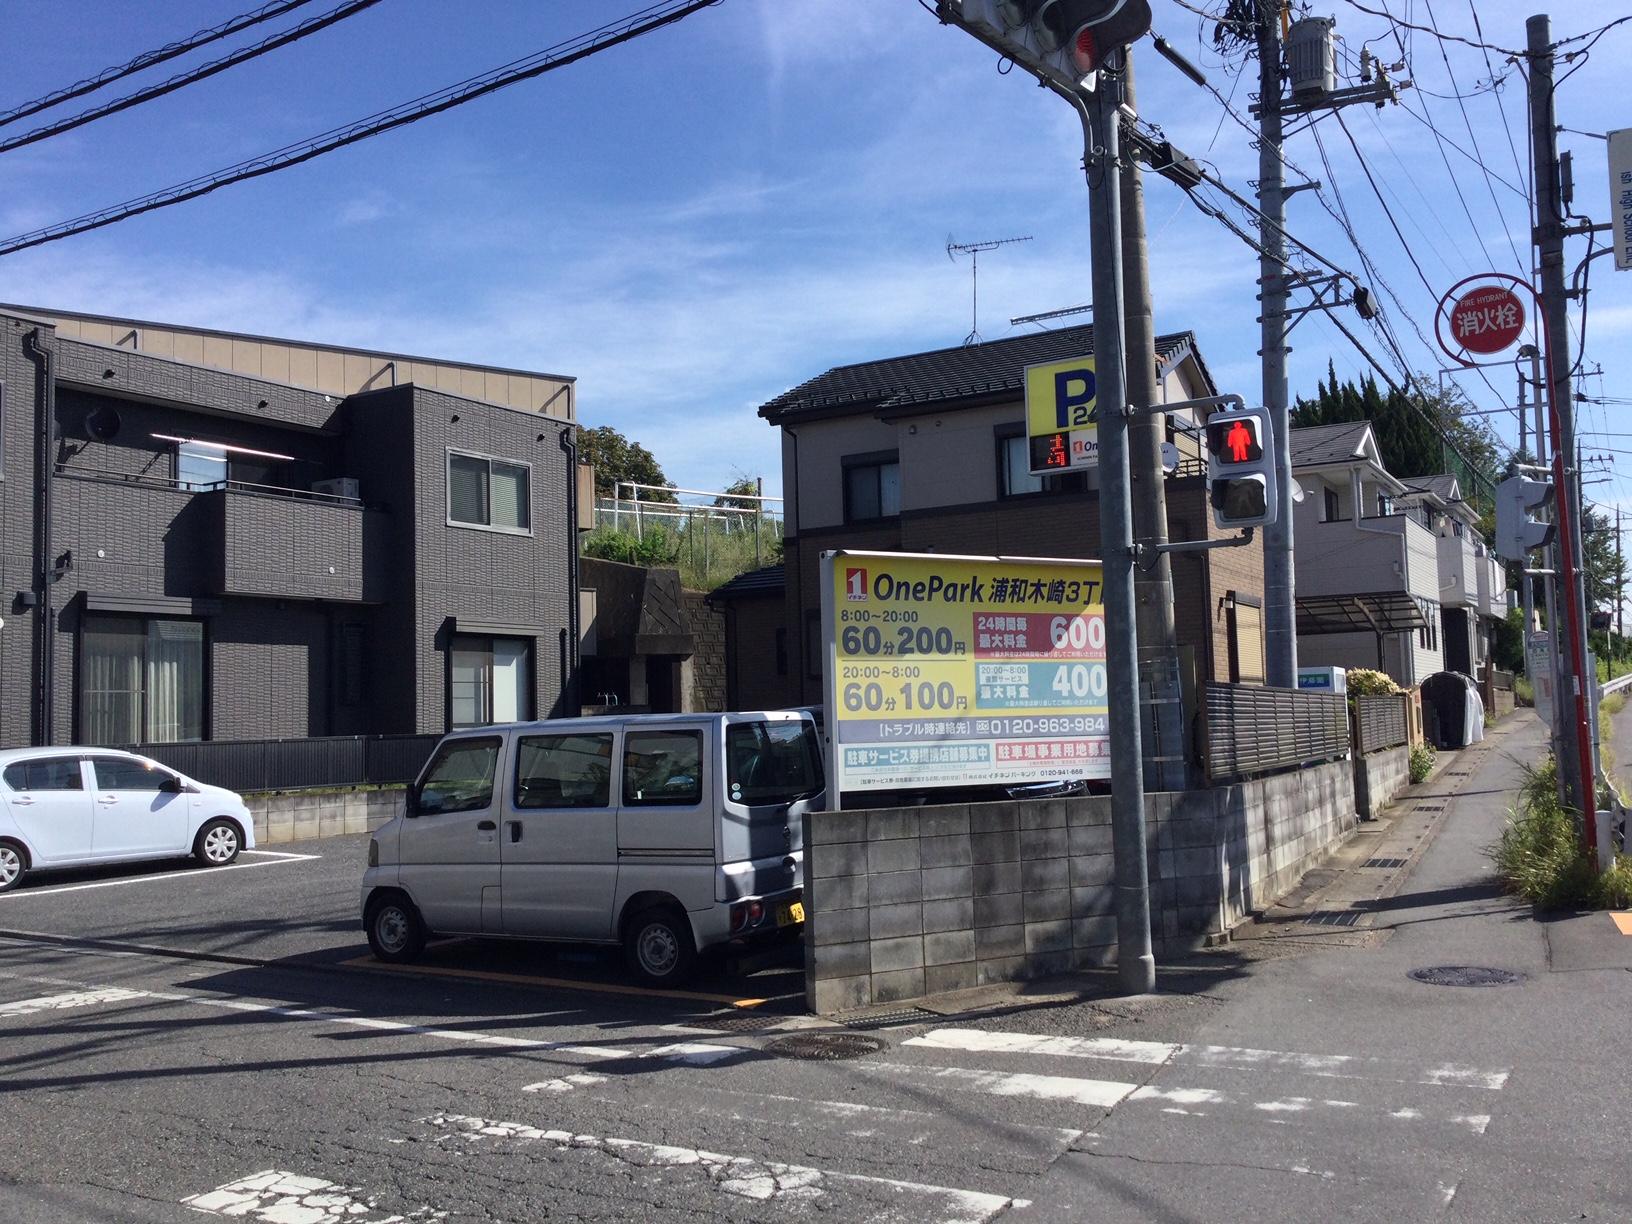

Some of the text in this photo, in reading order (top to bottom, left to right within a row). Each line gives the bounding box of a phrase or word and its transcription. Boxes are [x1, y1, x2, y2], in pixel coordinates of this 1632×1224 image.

[1460, 292, 1508, 307] FIRE HYDRANT
[1456, 303, 1519, 337] 消火栓
[1055, 369, 1097, 429] P
[873, 573, 1105, 605] OnePark 浦和木崎3丁
[1052, 664, 1107, 697] 400
[991, 718, 1105, 734] 0120-963-984
